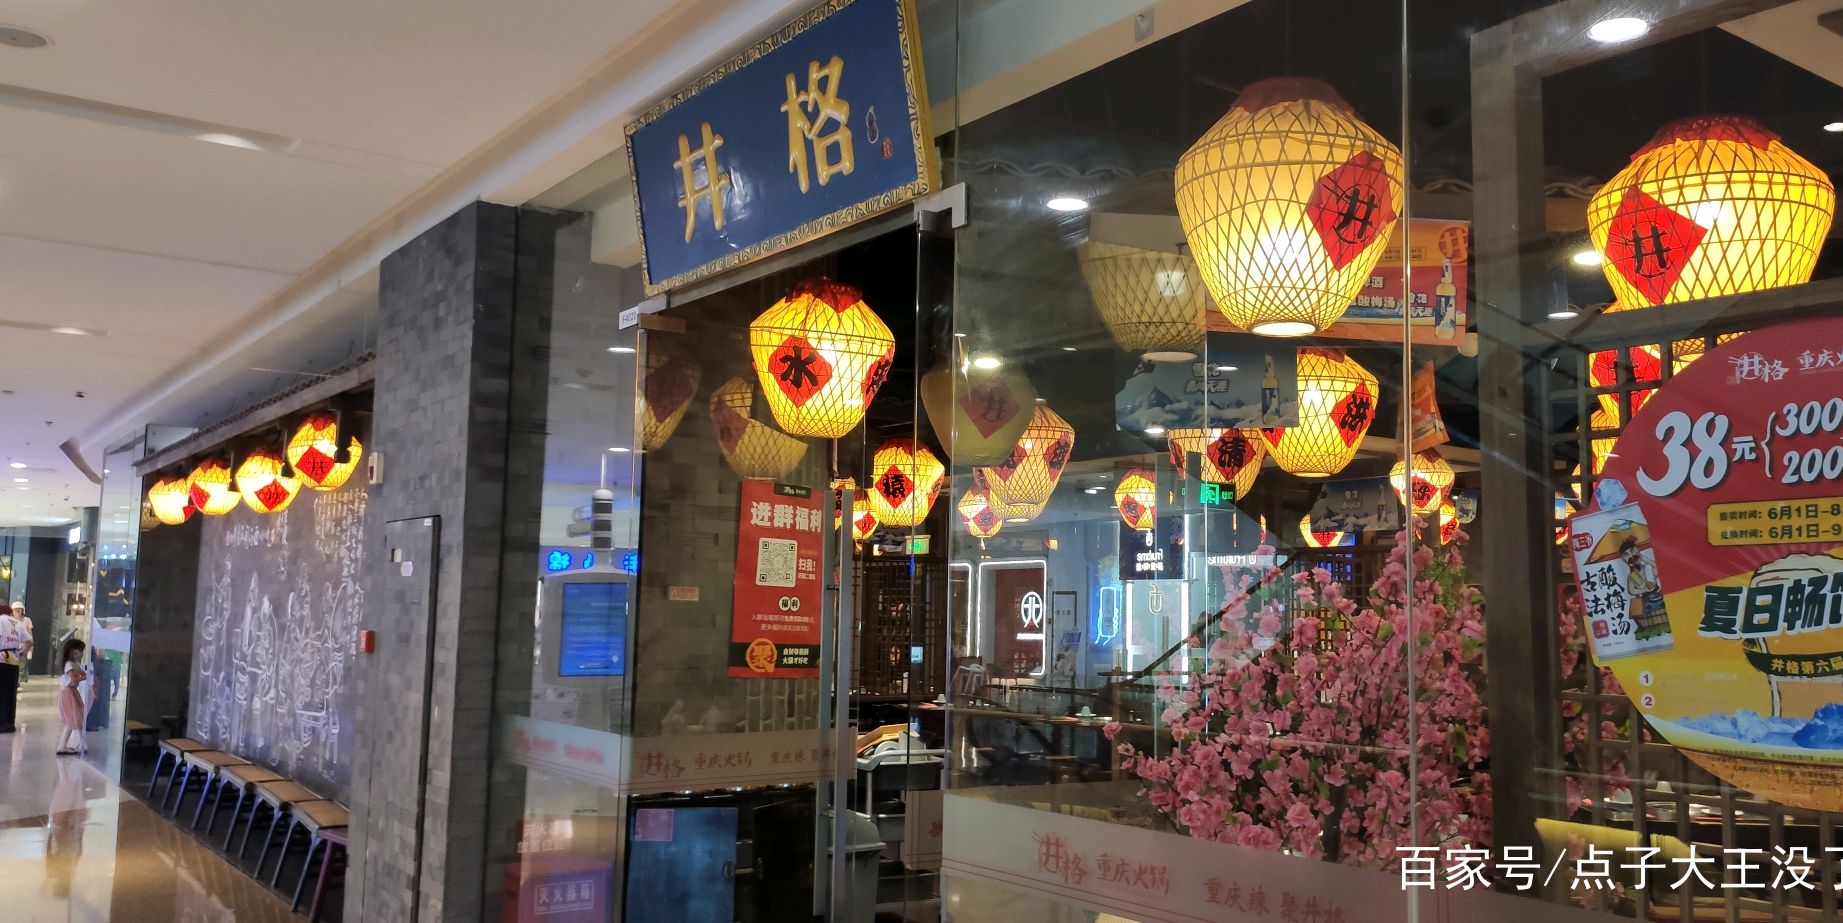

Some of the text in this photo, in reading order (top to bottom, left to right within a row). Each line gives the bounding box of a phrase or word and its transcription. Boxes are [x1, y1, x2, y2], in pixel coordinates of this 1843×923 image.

[673, 55, 855, 242] 井格
[1333, 186, 1378, 242] 井
[1629, 224, 1670, 276] 井
[778, 345, 820, 388] 水
[1775, 397, 1843, 437] 300
[1781, 445, 1843, 484] 200
[750, 501, 822, 533] 进群福利
[1096, 852, 1169, 895] 重庆火锅
